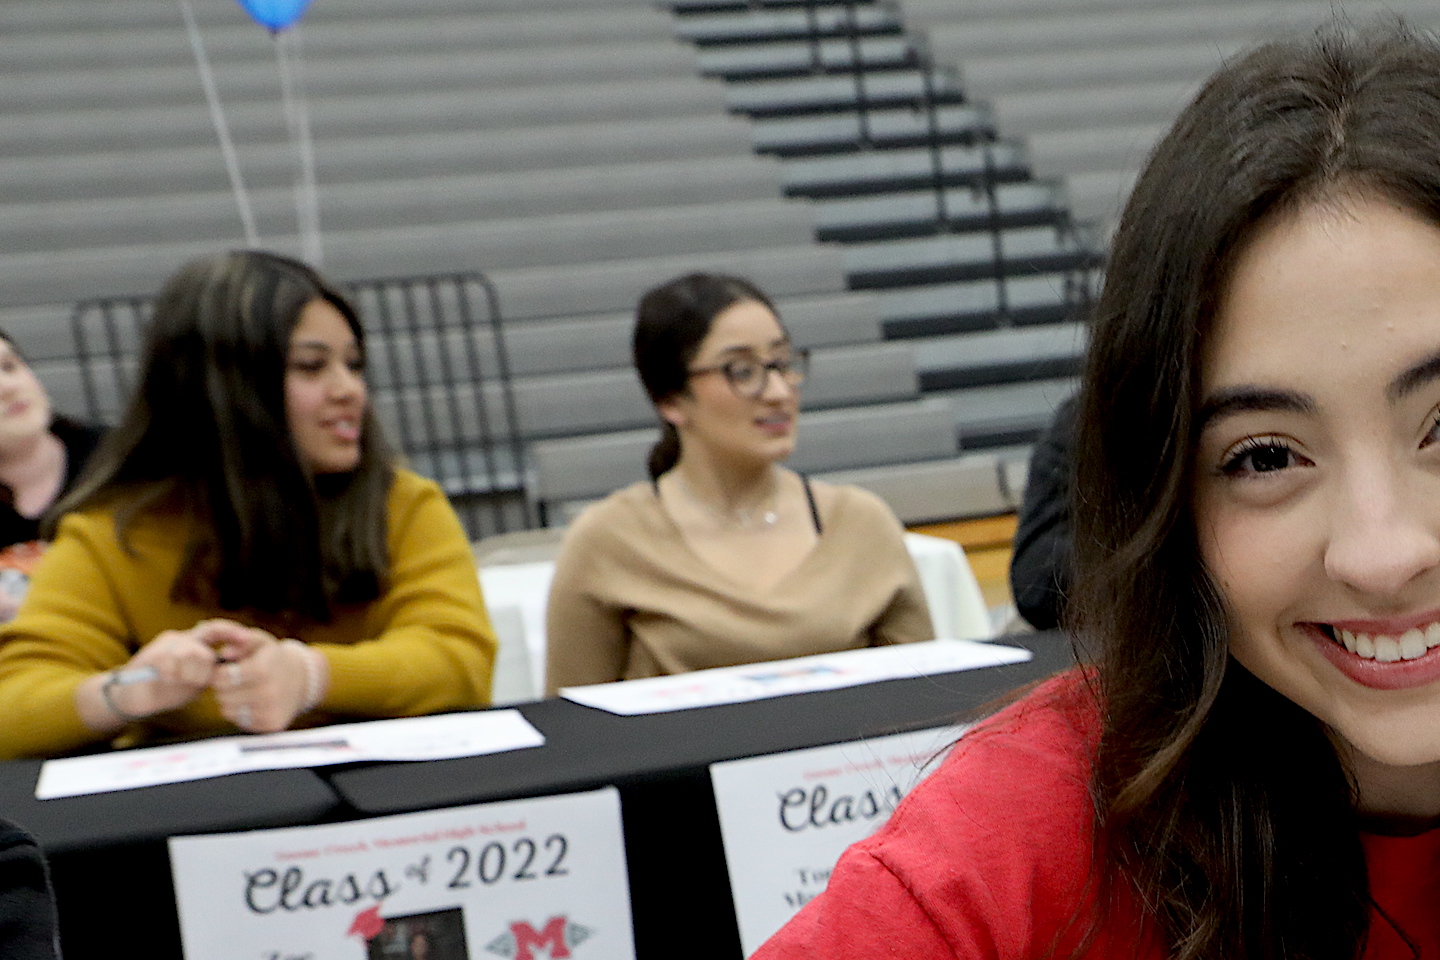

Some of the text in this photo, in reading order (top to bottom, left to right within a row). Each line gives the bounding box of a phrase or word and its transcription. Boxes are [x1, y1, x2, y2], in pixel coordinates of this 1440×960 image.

[243, 833, 569, 915] Class of 2022
